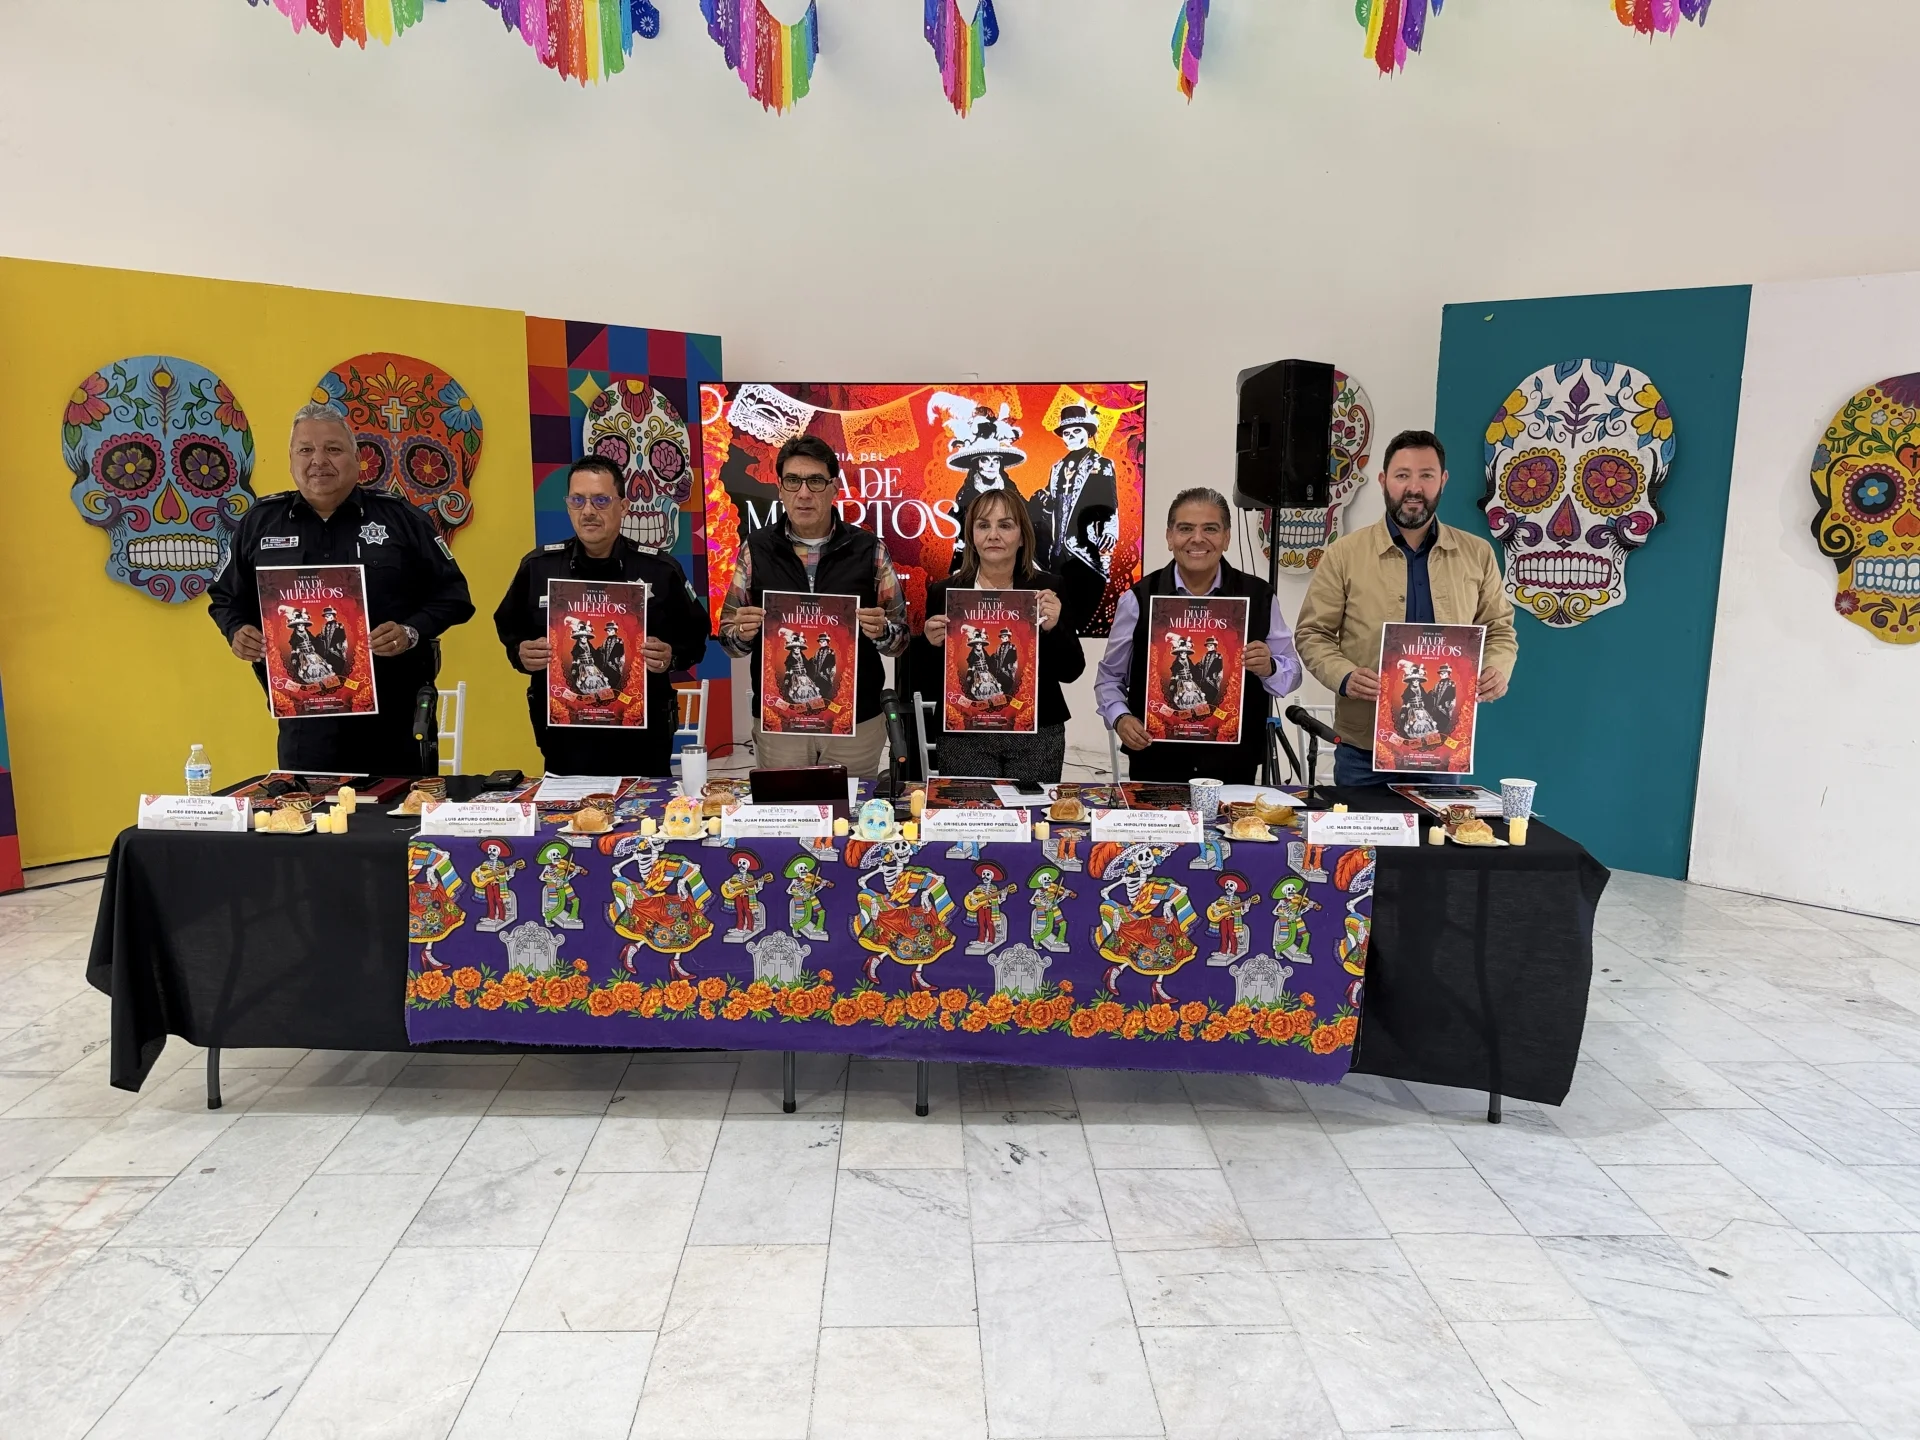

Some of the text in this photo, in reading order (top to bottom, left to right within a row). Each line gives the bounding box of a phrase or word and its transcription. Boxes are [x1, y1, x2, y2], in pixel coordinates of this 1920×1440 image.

[834, 452, 885, 462] RIA DEL
[860, 467, 903, 499] DE
[746, 499, 962, 540] MRTOS
[312, 579, 325, 590] DE
[280, 587, 344, 600] MUERTOS
[598, 594, 611, 603] DE
[568, 601, 627, 614] MUERTOS
[812, 606, 824, 615] DE
[993, 602, 1005, 611] DE
[782, 613, 839, 626] MUERTOS
[964, 610, 1020, 621] MUERTOS
[1200, 610, 1212, 620] DE
[1169, 617, 1227, 630] MUERTOS
[1434, 637, 1446, 647] DE
[1402, 644, 1462, 657] MUERTOS
